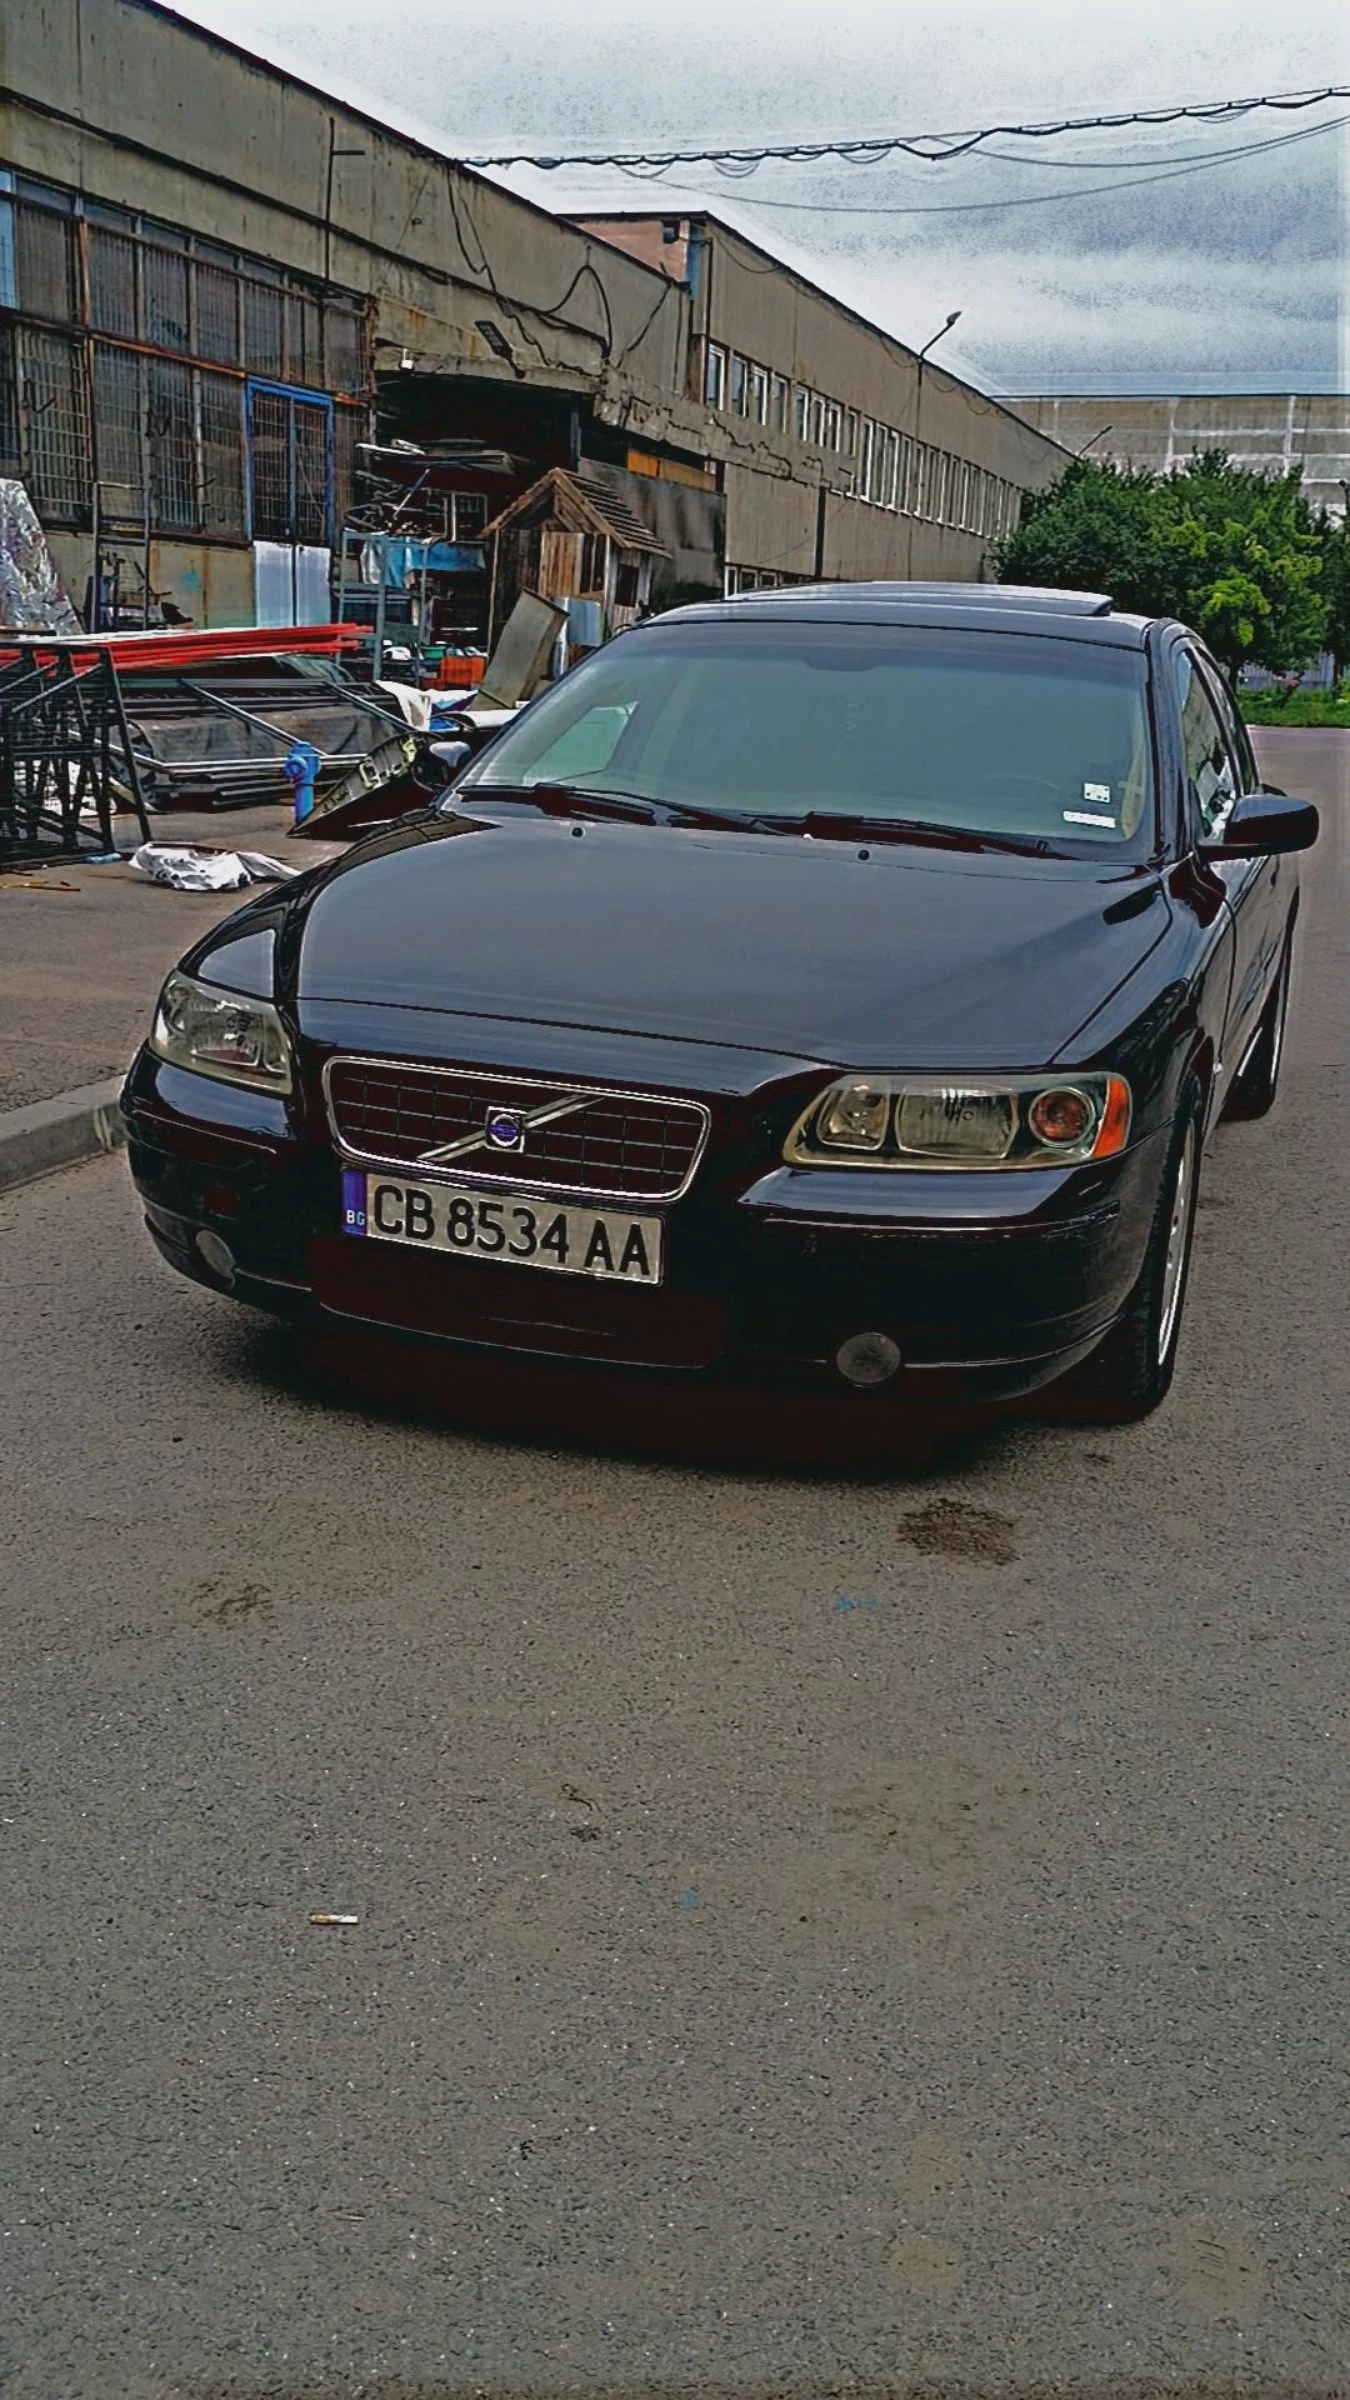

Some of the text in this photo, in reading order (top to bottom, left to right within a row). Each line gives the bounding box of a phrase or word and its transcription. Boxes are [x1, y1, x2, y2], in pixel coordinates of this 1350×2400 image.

[346, 1209, 366, 1226] BG
[374, 1184, 651, 1276] CB 8534 AA
